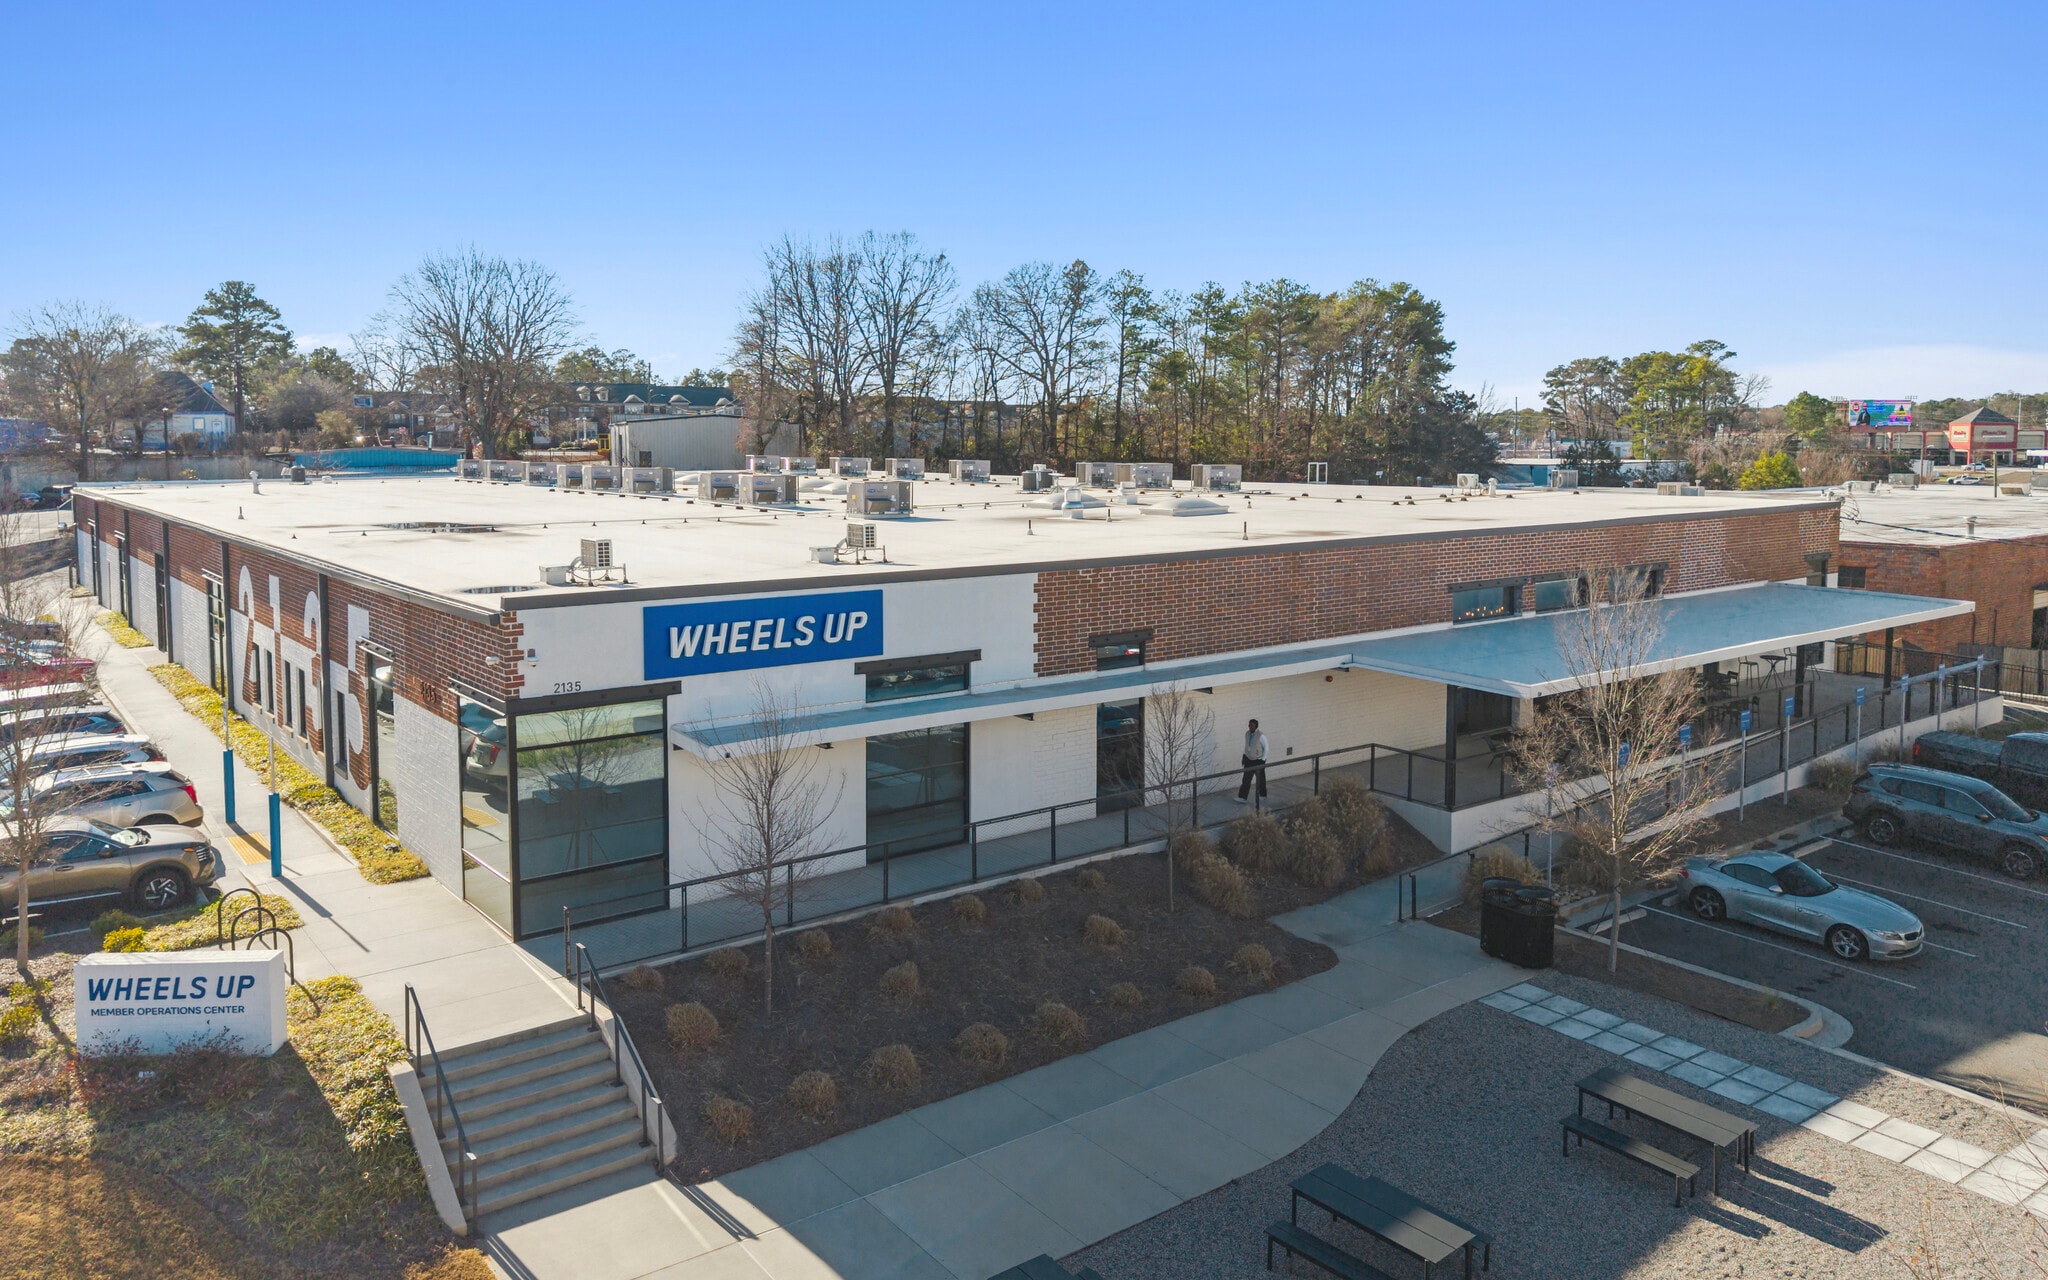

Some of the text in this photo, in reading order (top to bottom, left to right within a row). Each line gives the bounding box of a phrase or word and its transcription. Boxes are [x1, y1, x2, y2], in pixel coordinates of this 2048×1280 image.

[669, 611, 868, 659] WHEELS UP
[238, 565, 371, 791] 2135
[554, 681, 582, 694] 2135
[88, 975, 255, 1001] WHEELS UP
[91, 1005, 245, 1017] MEMBER OPERATIONS CENTER
